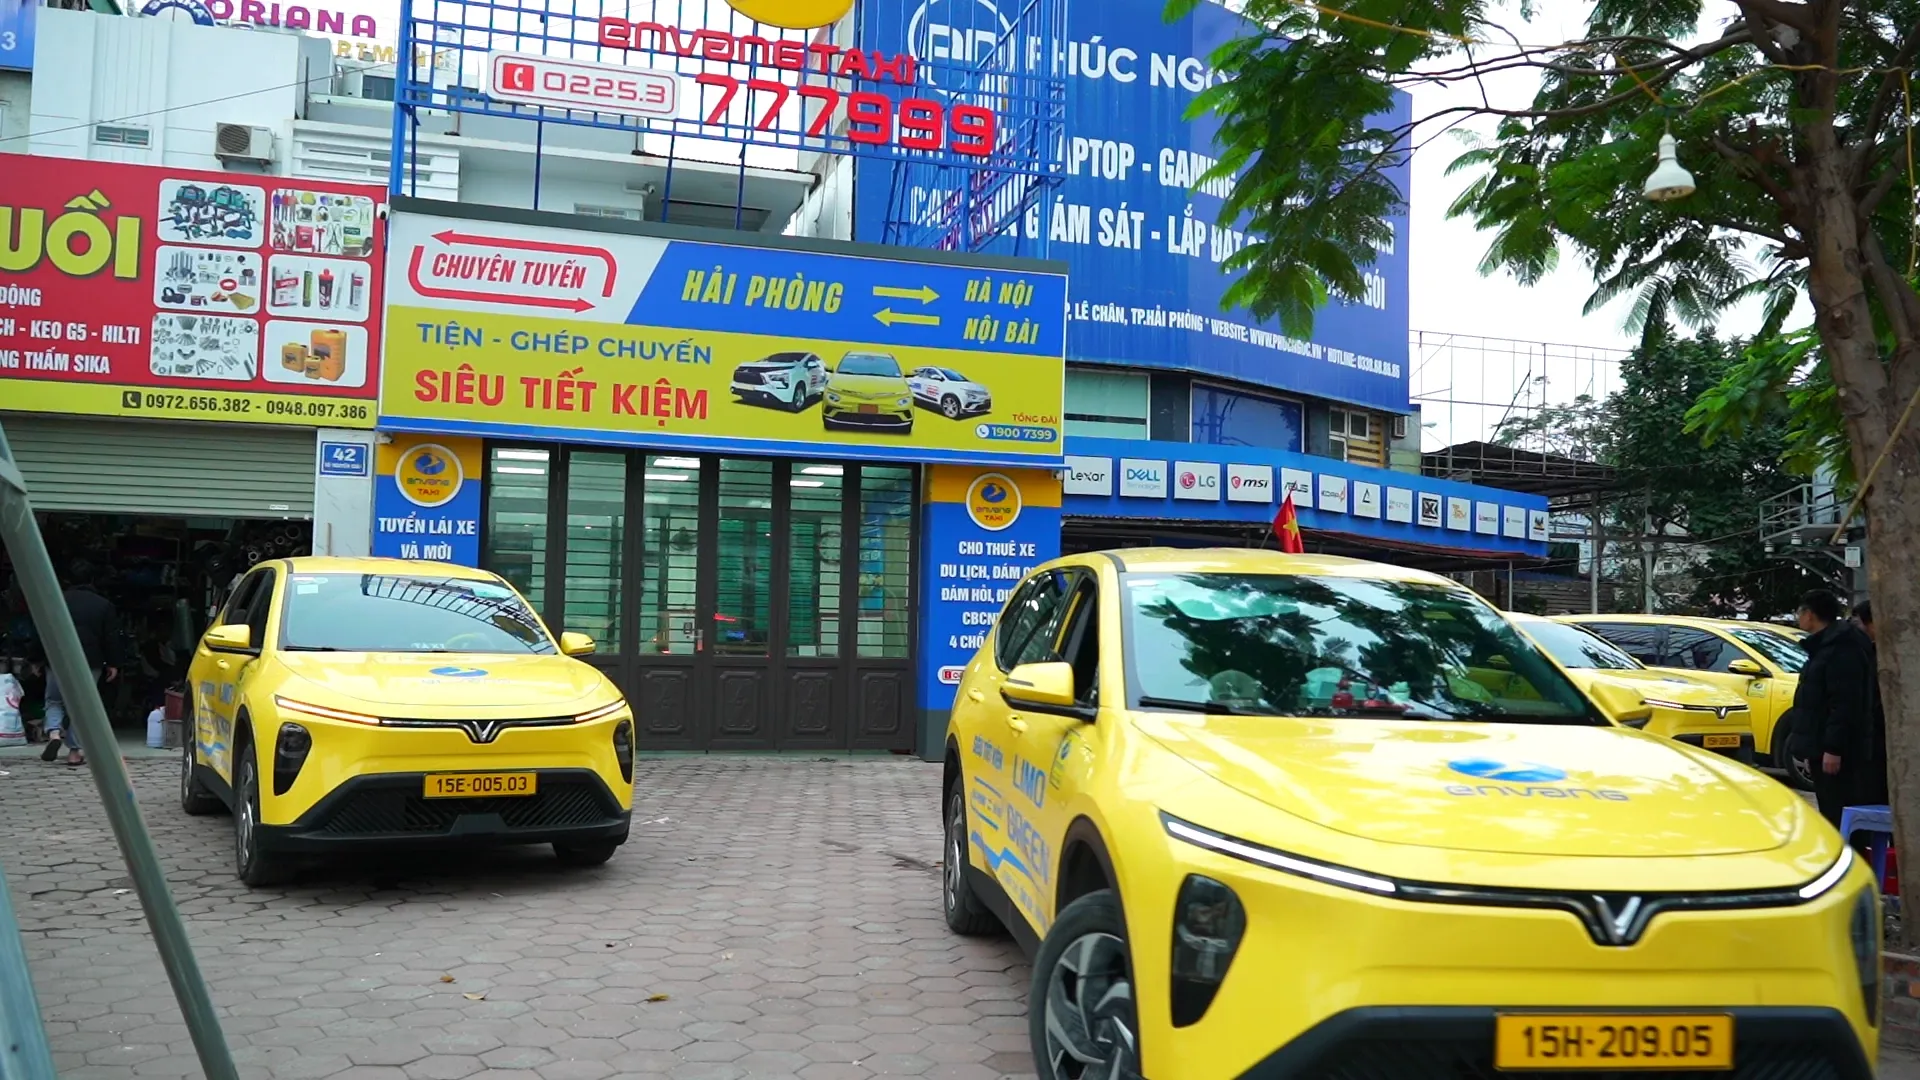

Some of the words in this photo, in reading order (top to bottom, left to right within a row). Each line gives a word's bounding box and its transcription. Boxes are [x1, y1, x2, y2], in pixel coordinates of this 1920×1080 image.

[809, 44, 917, 85] TAXI
[1150, 52, 1229, 93] NG
[543, 74, 666, 104] 0225.3
[695, 73, 996, 157] 777999
[1049, 136, 1135, 181] APTOP
[1026, 194, 1091, 245] GÁM
[1098, 202, 1145, 250] SÁT
[1168, 203, 1206, 258] LẮP
[432, 253, 517, 284] CHUYÊN
[521, 259, 587, 289] TUYẾN
[681, 265, 738, 306] HẢI
[745, 271, 844, 314] PHÒNG
[964, 279, 992, 303] HÀ
[997, 279, 1034, 307] NỘI
[1363, 268, 1386, 310] GÓI
[30, 320, 62, 340] KEO
[66, 322, 87, 341] G5
[102, 325, 140, 345] HILTI
[963, 315, 999, 343] NỘI
[1004, 318, 1040, 345] BÀI
[1075, 300, 1089, 320] LÊ
[1092, 302, 1128, 326] CHÂN,
[1169, 308, 1204, 332] PHÒNG
[1211, 318, 1249, 344] WEBSITE:
[417, 321, 482, 351] TIỆN
[510, 329, 590, 355] GHÉP
[598, 338, 711, 365] CHUYẾN
[24, 346, 70, 371] THẤM
[73, 354, 111, 374] SIKA
[146, 394, 251, 413] 0972.656.382
[266, 400, 367, 420] 0948.097.386
[414, 363, 504, 407] SIÊU
[520, 366, 597, 413] TIẾT
[612, 378, 708, 427] KIỆM
[992, 427, 1020, 438] 1900
[1023, 429, 1052, 440] 7399
[333, 447, 357, 462] 42
[1127, 468, 1160, 482] DELL
[1198, 475, 1216, 488] LG
[1243, 479, 1268, 489] msi
[417, 488, 439, 496] TAXI
[378, 511, 425, 534] TUYỂN
[429, 516, 452, 535] LÁI
[456, 520, 475, 535] XE
[984, 514, 1003, 522] TAXI
[401, 541, 419, 559] VÀ
[423, 541, 451, 560] MỜI
[959, 541, 983, 556] CHO
[986, 540, 1016, 557] THUÊ
[1019, 543, 1036, 557] XE
[941, 563, 957, 577] DU
[960, 564, 990, 581] LỊCH,
[992, 562, 1020, 580] ĐÁM
[941, 586, 969, 602] ĐÁM
[949, 635, 957, 648] 4
[436, 777, 527, 795] 15E-005.03
[1014, 753, 1046, 809] LIMO
[1521, 1024, 1713, 1059] 15H-209.05
